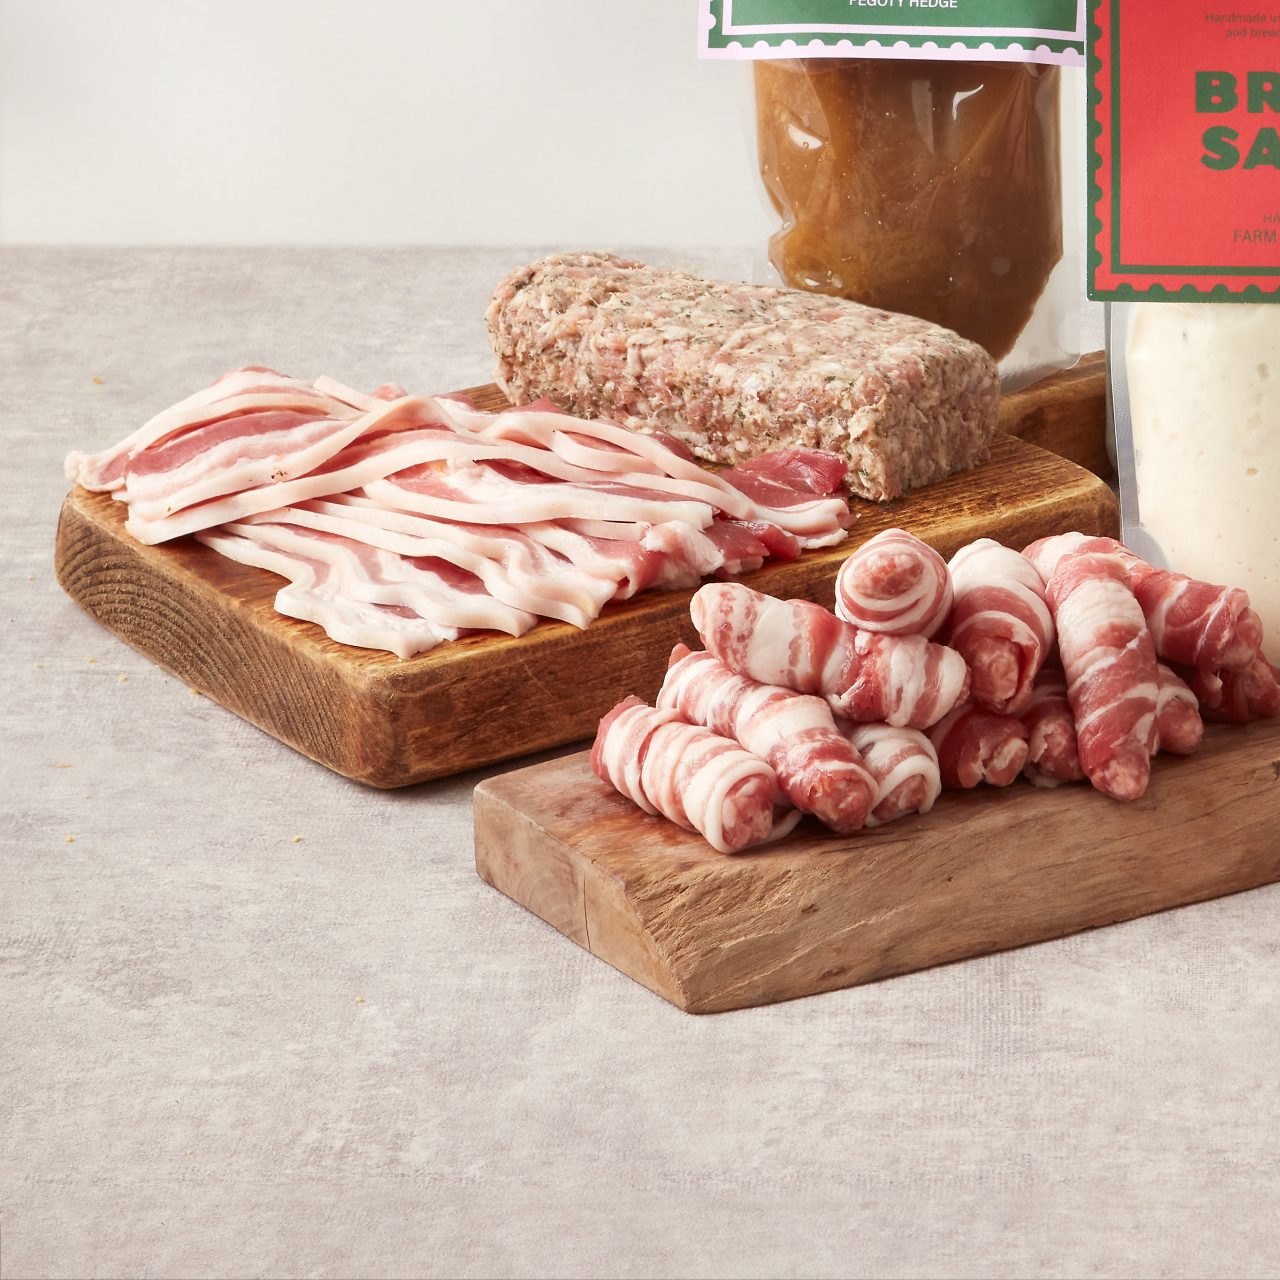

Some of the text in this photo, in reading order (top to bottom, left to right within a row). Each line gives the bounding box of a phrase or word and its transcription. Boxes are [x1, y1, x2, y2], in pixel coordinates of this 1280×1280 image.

[1205, 12, 1267, 23] Handmade
[1226, 27, 1247, 38] and
[1233, 229, 1277, 243] FARM
